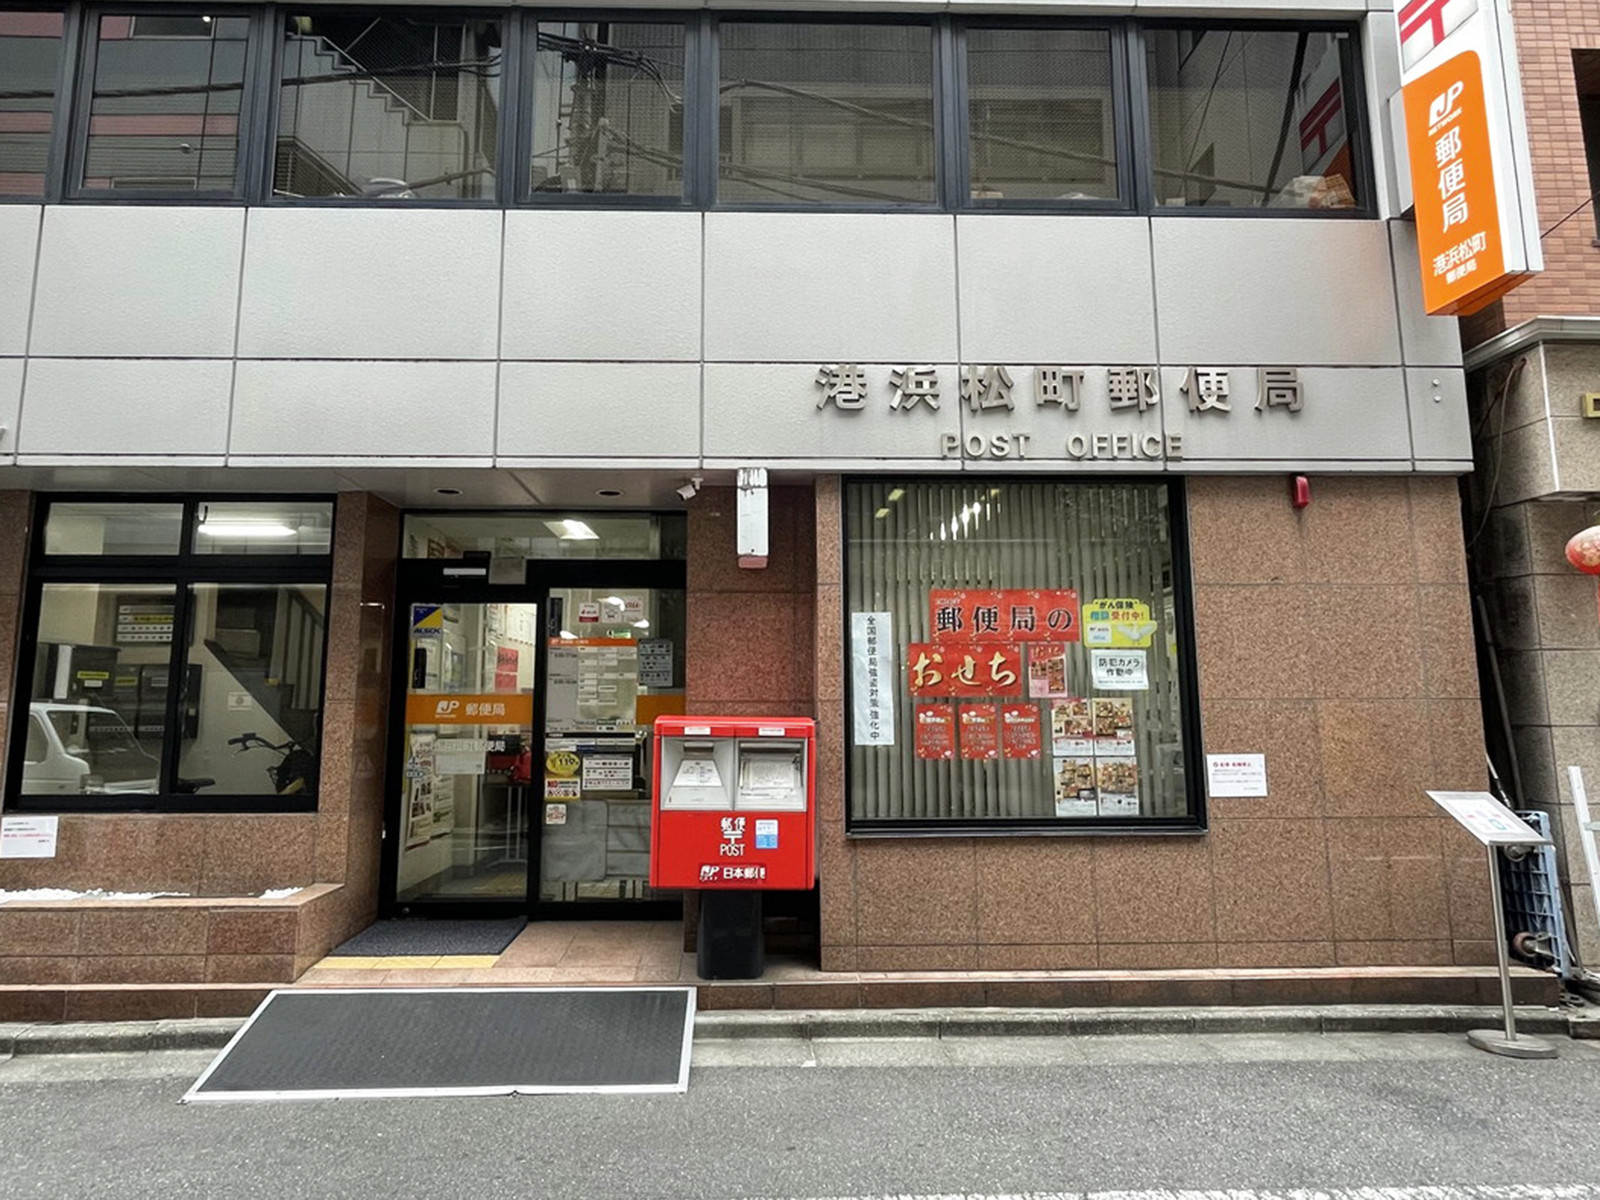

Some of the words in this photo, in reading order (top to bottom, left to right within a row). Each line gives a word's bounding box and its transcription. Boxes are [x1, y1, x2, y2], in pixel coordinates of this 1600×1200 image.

[1435, 125, 1469, 234] 郵便局
[1433, 230, 1487, 277] 港浜松町
[814, 363, 1305, 413] 港浜松町郵便局
[940, 432, 1031, 459] POST
[1066, 432, 1183, 461] OFFICE
[935, 605, 1074, 634] 郵便局の
[912, 650, 1017, 689] おせち
[465, 702, 507, 717] 郵便局
[720, 817, 746, 831] 郵便
[720, 843, 745, 856] POST
[723, 867, 766, 879] 日本郵便
